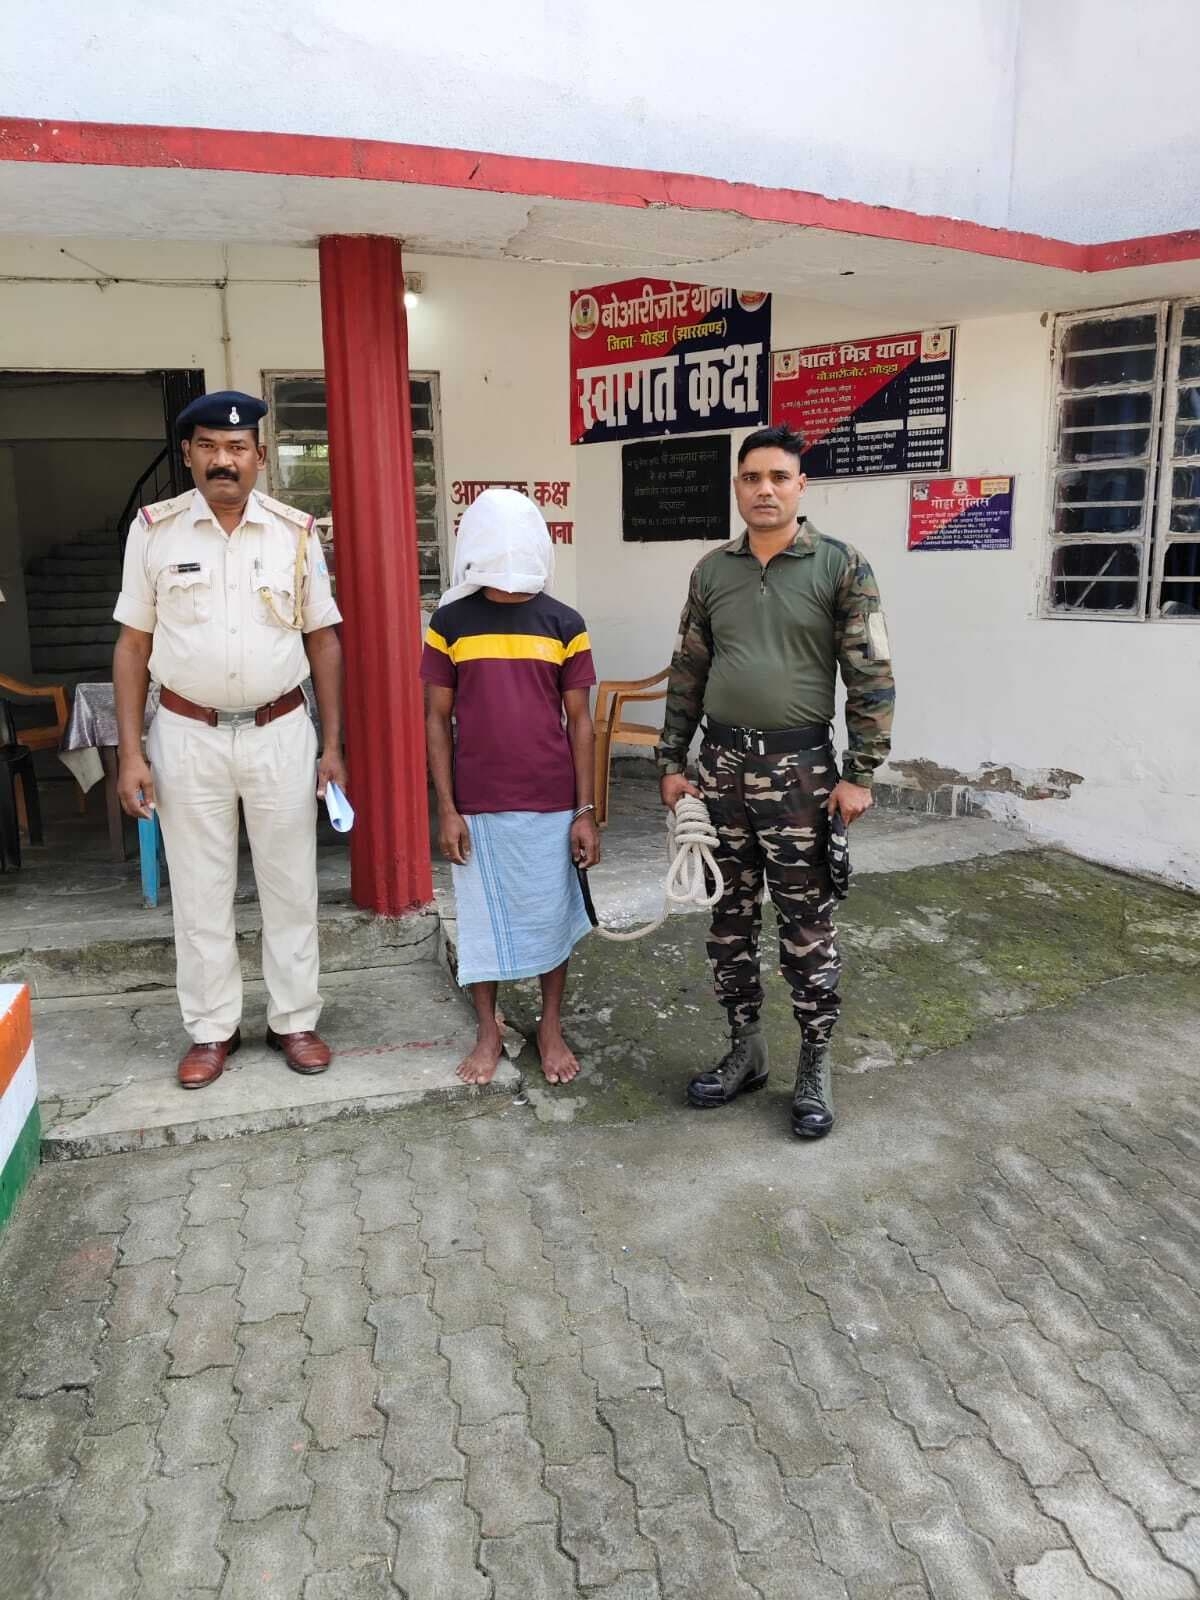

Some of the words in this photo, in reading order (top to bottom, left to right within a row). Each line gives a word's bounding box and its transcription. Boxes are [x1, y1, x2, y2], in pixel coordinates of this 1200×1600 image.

[601, 283, 690, 328] बोआरीजोर
[691, 286, 733, 314] थाना
[800, 351, 836, 369] बाल
[838, 344, 872, 364] मित्र
[875, 340, 918, 359] थाना
[576, 354, 680, 430] स्वागत
[684, 342, 764, 417] कक्ष
[534, 481, 570, 509] कक्ष
[957, 494, 991, 513] पुलिस
